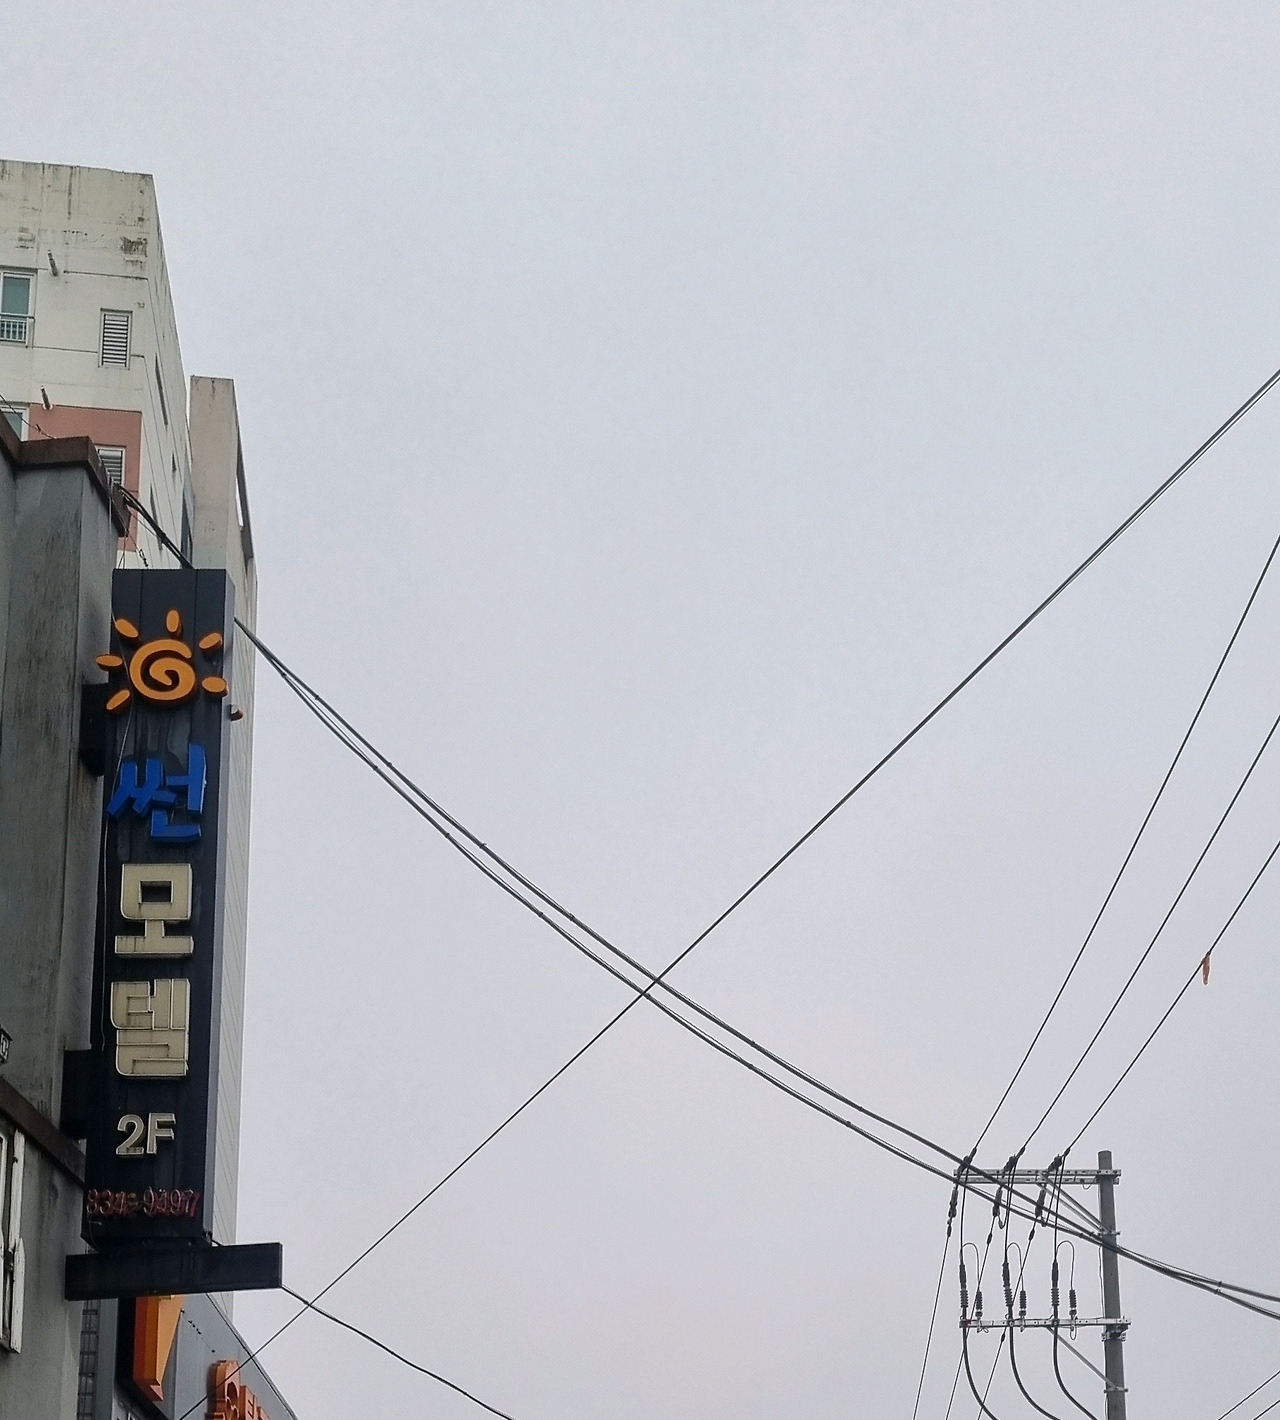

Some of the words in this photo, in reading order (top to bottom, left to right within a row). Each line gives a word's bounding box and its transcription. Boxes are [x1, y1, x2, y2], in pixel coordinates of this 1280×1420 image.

[108, 744, 207, 843] 썬
[109, 862, 195, 1081] 모텔
[115, 1112, 177, 1157] 2F
